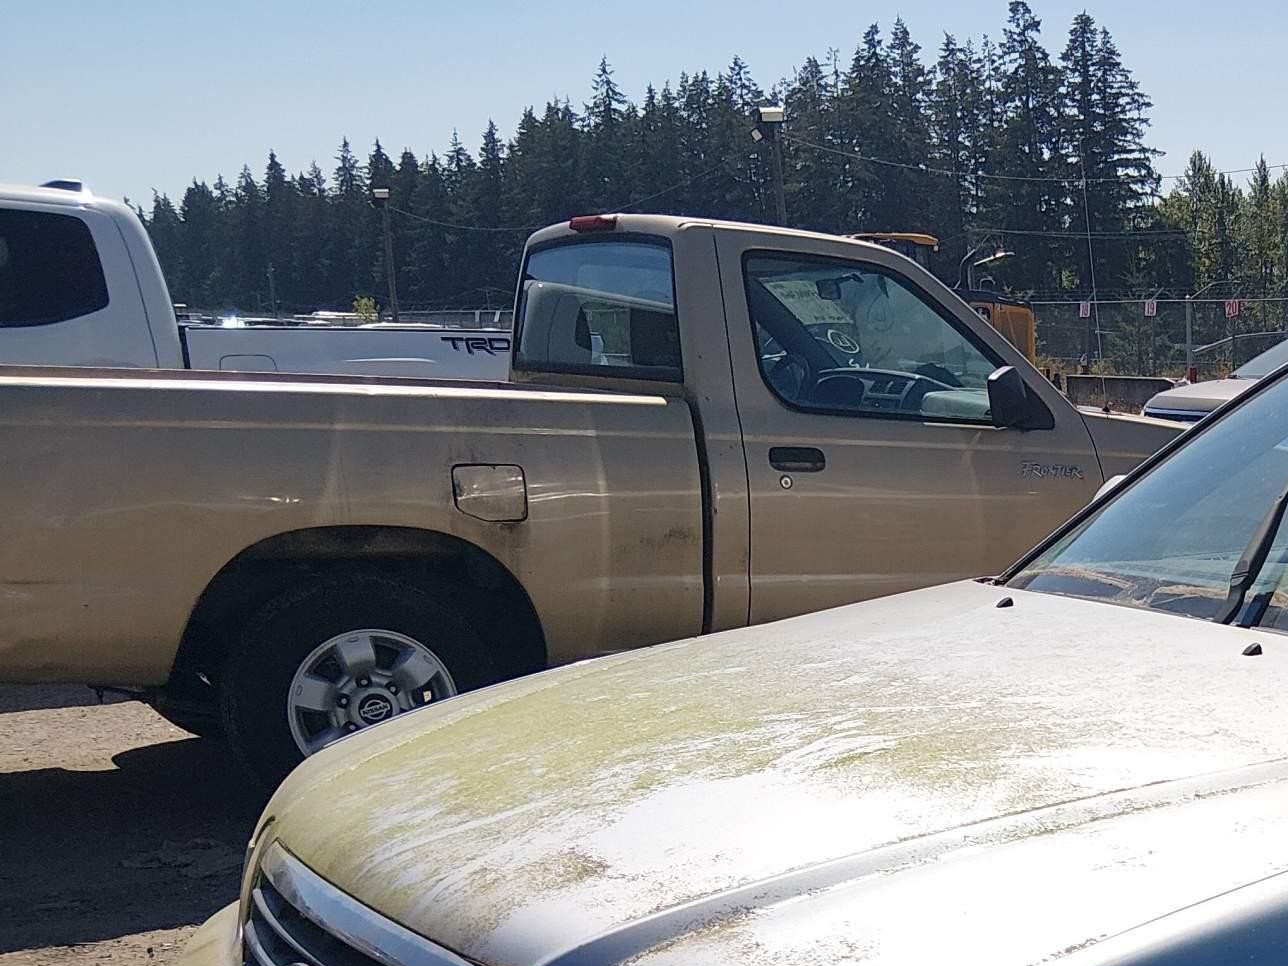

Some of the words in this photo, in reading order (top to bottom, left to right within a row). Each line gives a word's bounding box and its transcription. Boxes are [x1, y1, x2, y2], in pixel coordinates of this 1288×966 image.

[1226, 301, 1237, 315] 20
[440, 336, 511, 356] TRD
[1022, 462, 1084, 480] FRONTIER
